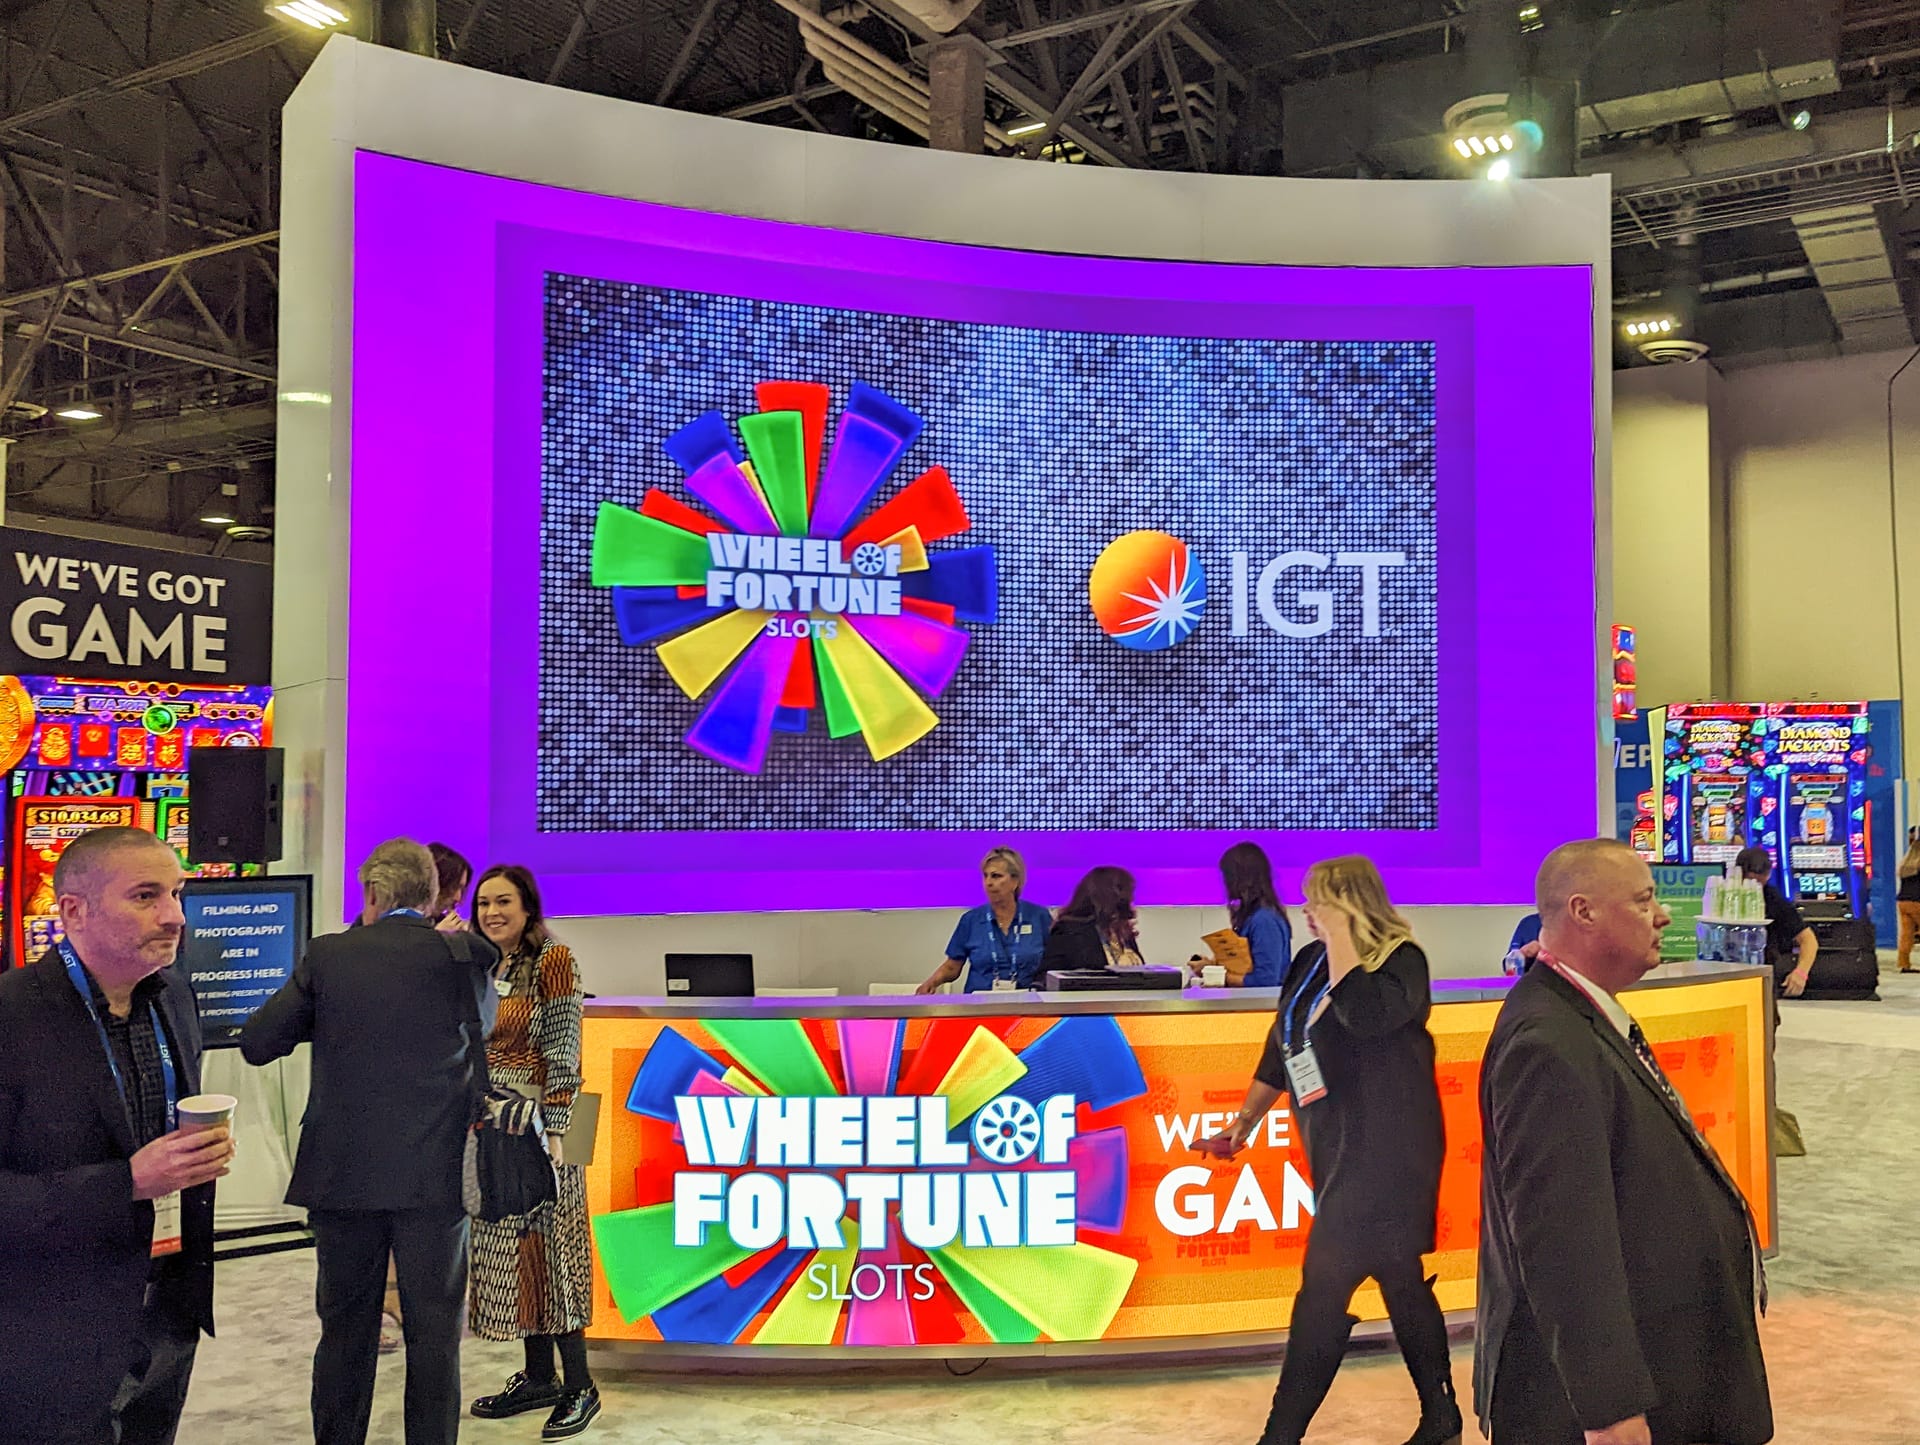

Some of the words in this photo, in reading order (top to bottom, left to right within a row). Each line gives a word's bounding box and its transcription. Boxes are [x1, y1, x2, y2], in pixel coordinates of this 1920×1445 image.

[706, 532, 850, 574] WHEEL
[14, 551, 139, 597] WE'VE
[147, 571, 226, 607] GOT
[706, 570, 902, 616] FORTUNE
[1232, 551, 1408, 638] IGT
[10, 596, 227, 673] GAME
[766, 618, 838, 640] SLOTS
[1780, 727, 1850, 740] DIAMOND
[1776, 739, 1850, 754] JACKPOTS
[202, 905, 251, 916] FILMING
[252, 904, 278, 914] AND
[194, 925, 286, 938] PHOTOGRAPHY
[220, 949, 244, 959] ARE
[246, 948, 259, 957] IN
[191, 970, 252, 983] PROGRESS
[254, 968, 286, 979] HERE.
[207, 990, 230, 999] BEING
[231, 989, 263, 998] PRESENT
[206, 1007, 248, 1017] PROVIDING
[160, 1043, 170, 1059] IGT
[167, 1099, 175, 1115] IGT
[674, 1095, 970, 1166] WHEEL
[673, 1171, 1077, 1249] FORTUNE
[806, 1263, 935, 1301] SLOTS
